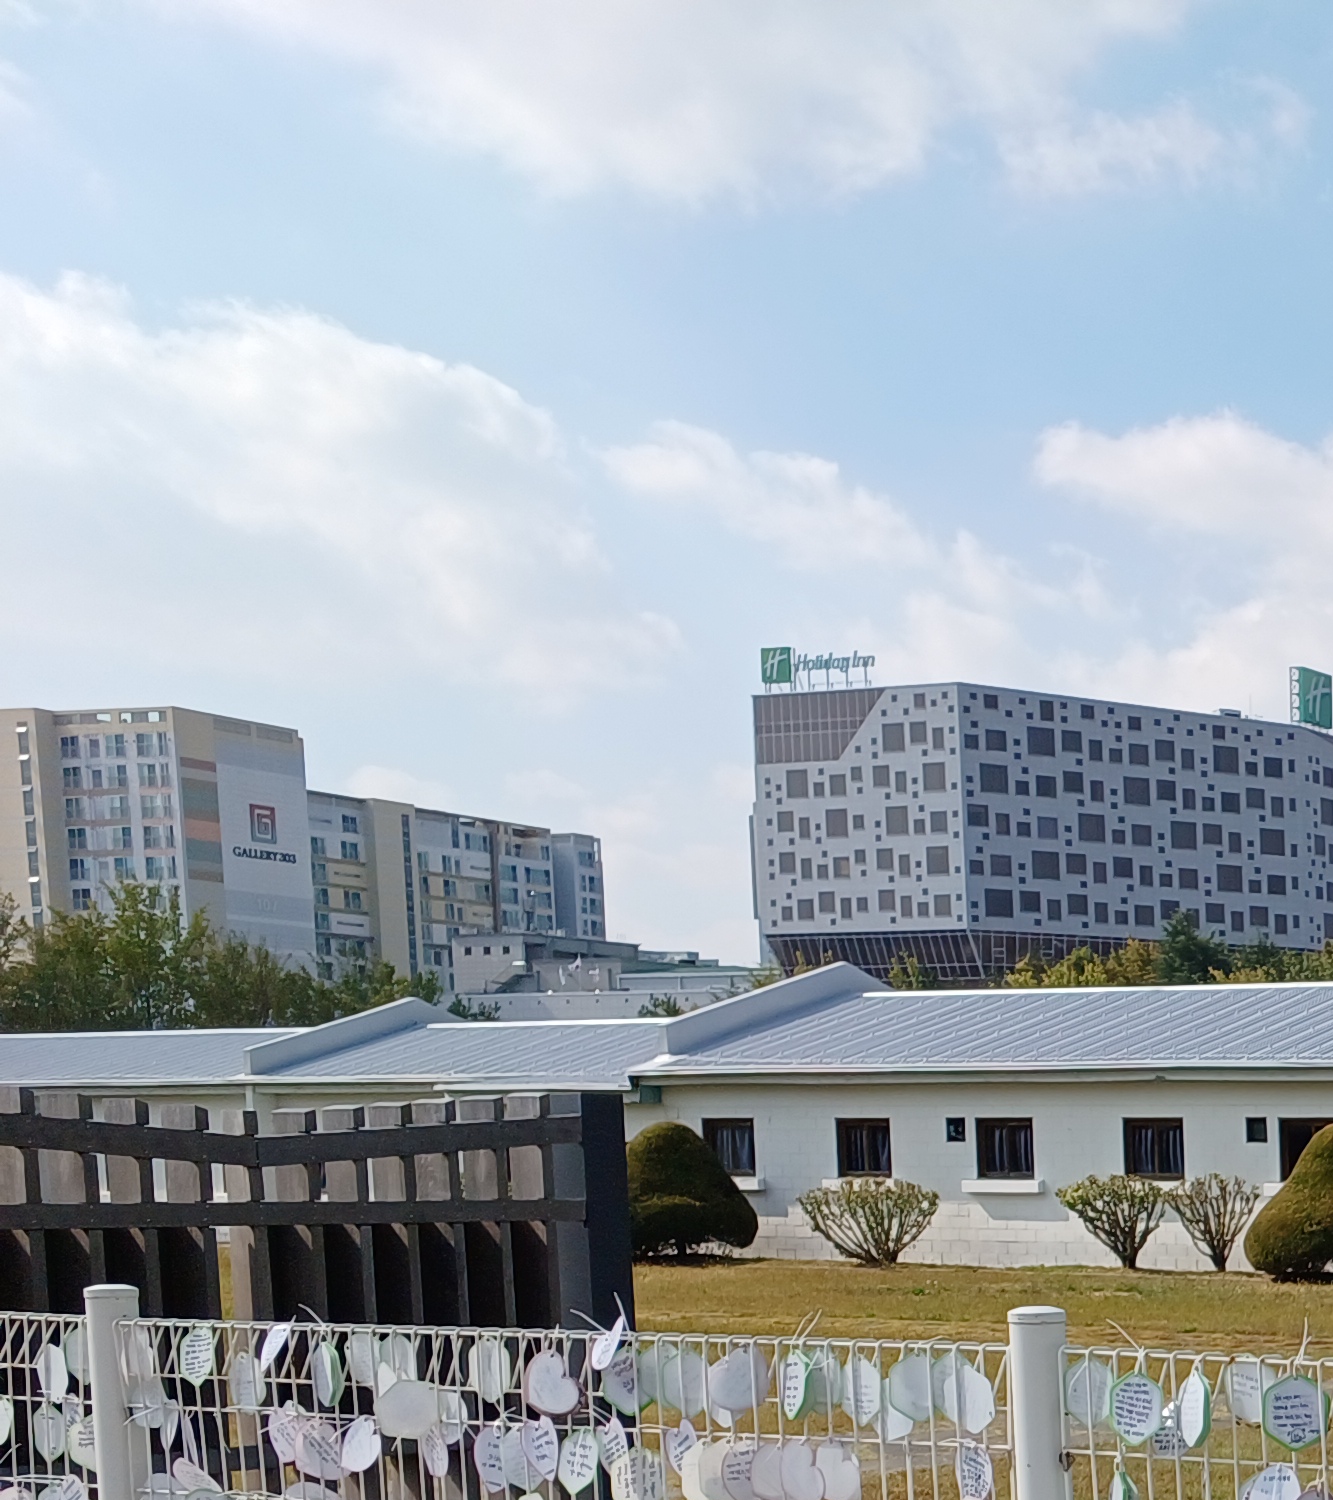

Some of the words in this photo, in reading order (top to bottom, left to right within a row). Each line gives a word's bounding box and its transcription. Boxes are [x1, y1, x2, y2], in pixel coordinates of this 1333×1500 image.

[794, 652, 850, 673] Holiday
[852, 650, 875, 668] Inn
[232, 846, 279, 861] GALLERY
